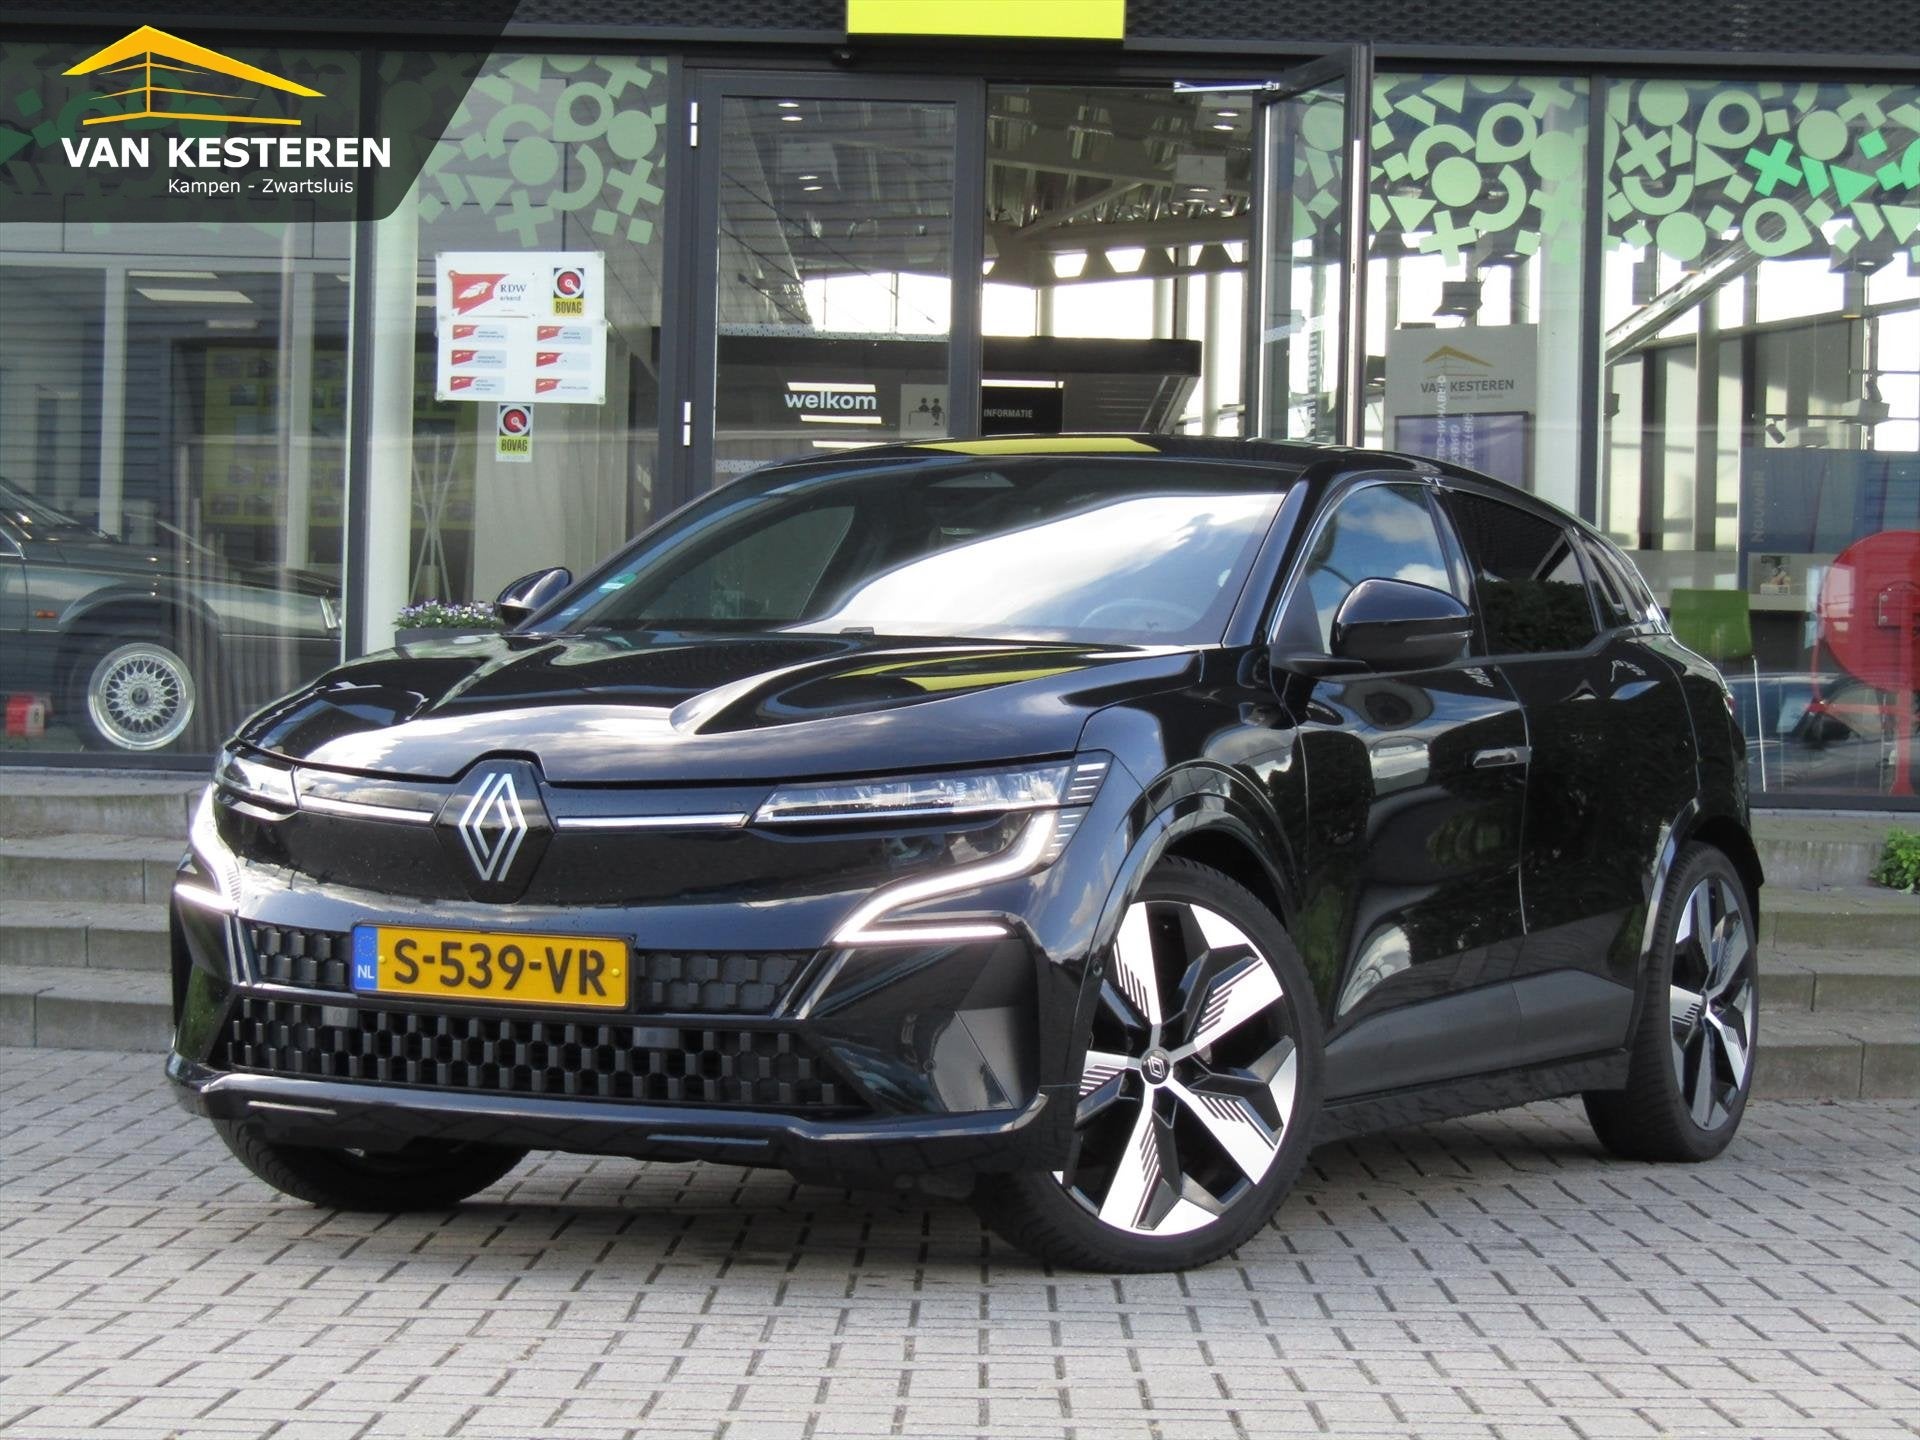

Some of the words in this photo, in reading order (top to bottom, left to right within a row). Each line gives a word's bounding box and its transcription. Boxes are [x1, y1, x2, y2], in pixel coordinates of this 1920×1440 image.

[500, 284, 527, 293] RDW
[555, 301, 582, 314] BOVAG
[1450, 379, 1514, 392] KESTEREN
[784, 390, 877, 410] welkom
[983, 408, 1033, 418] INFORMATIE
[501, 438, 528, 451] BOVAG
[357, 964, 375, 979] NL
[394, 938, 606, 997] S-539-VR
